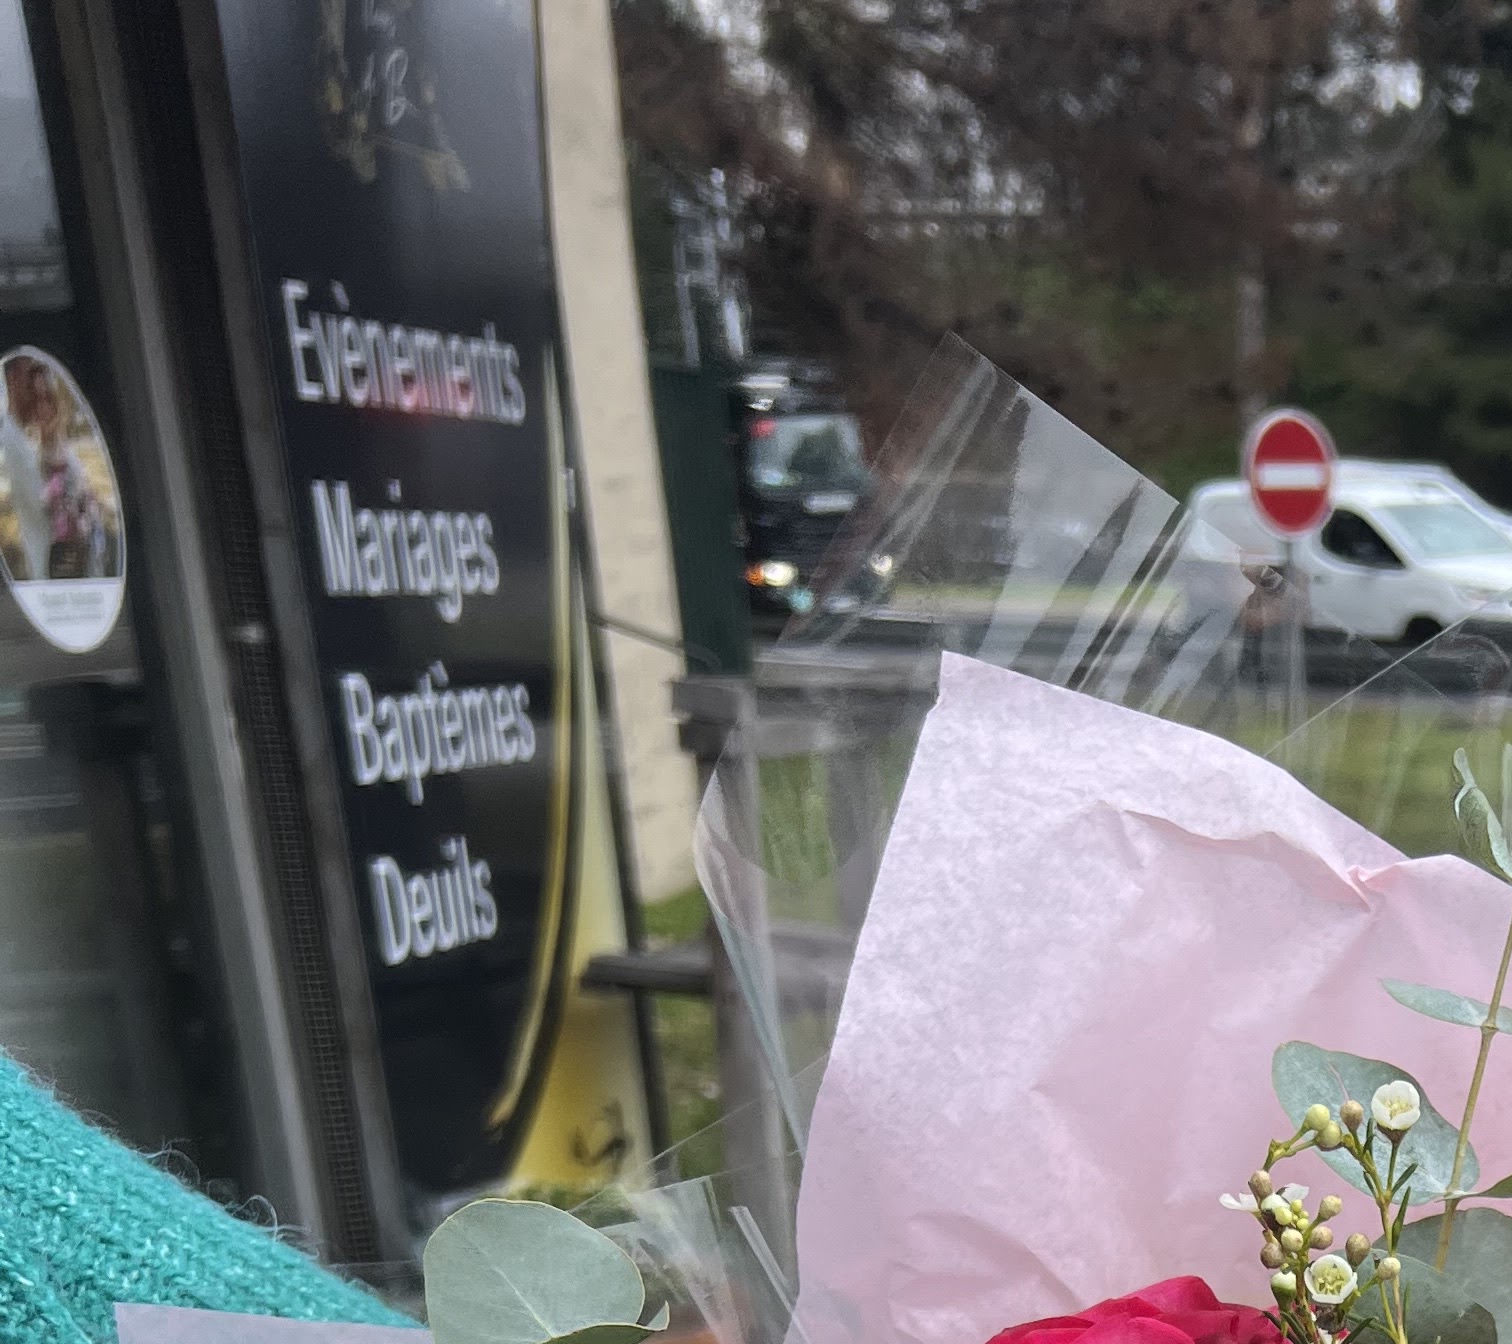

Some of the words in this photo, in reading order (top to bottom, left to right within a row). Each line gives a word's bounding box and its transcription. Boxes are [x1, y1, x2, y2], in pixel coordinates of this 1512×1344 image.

[281, 277, 525, 425] Evènements
[311, 478, 500, 623] Mariages
[370, 834, 498, 966] Deuils
